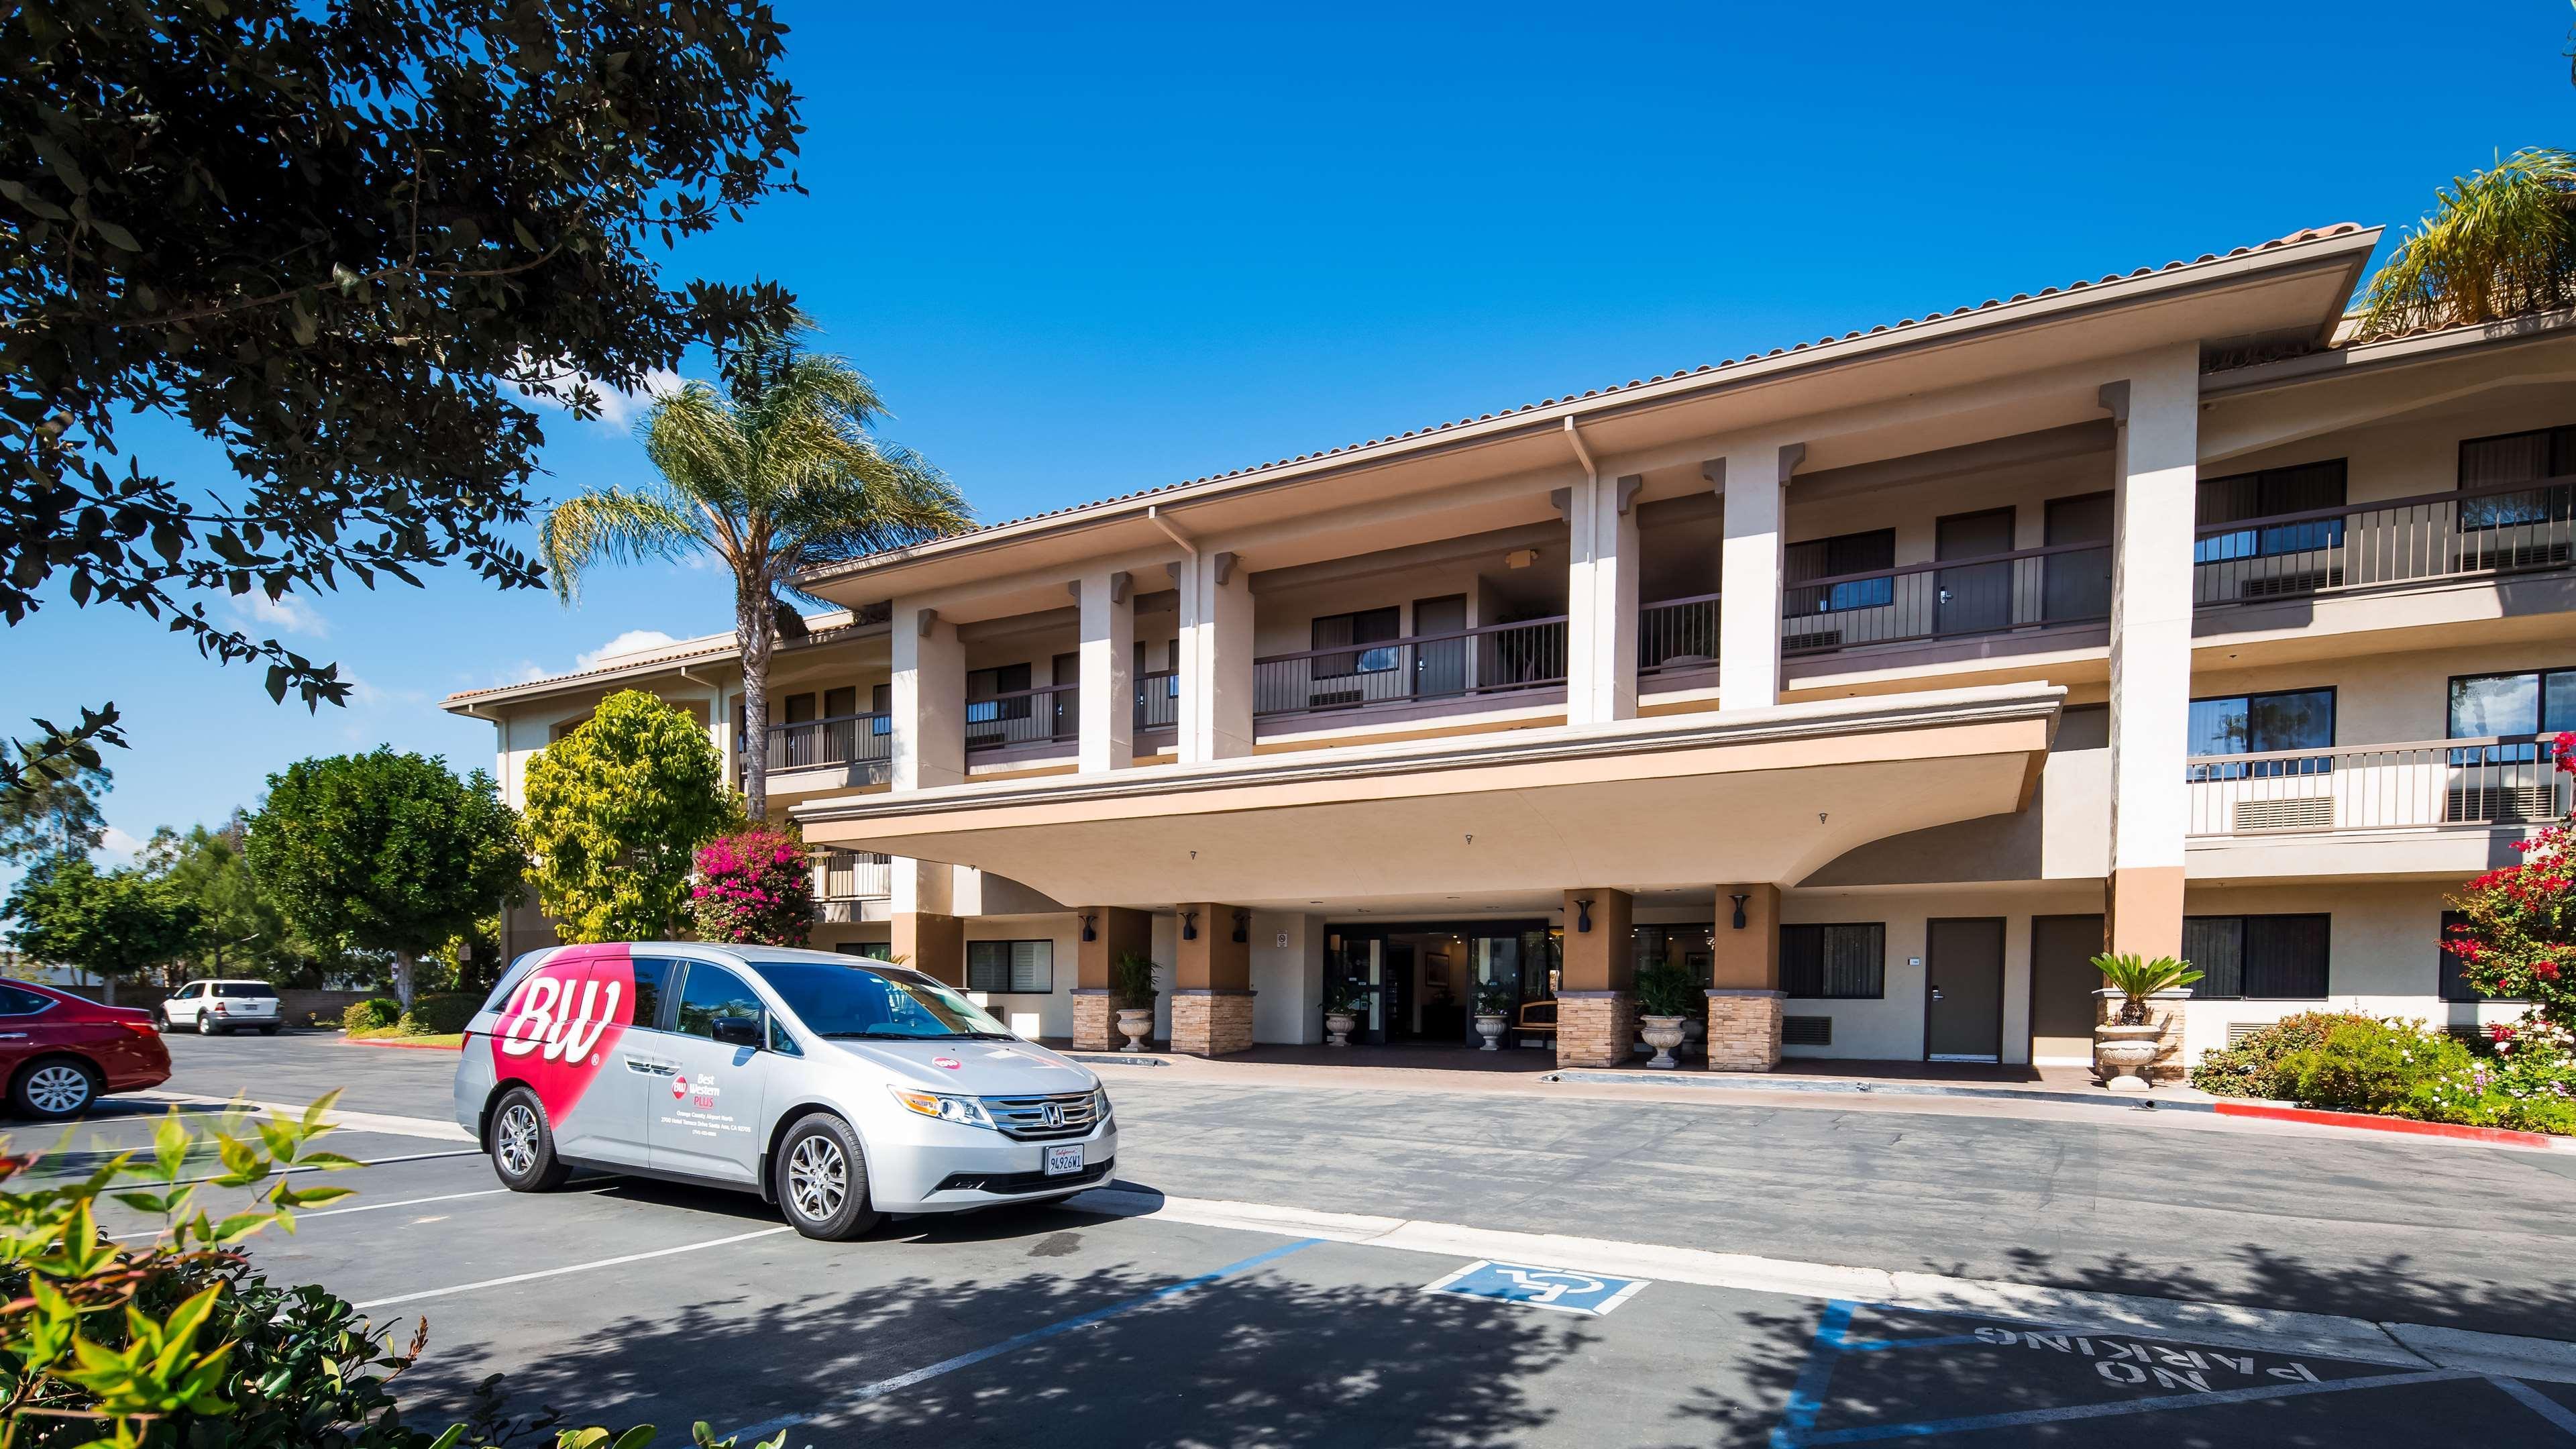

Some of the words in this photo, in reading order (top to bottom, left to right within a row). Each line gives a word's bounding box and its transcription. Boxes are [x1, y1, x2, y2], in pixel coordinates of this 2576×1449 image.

[502, 977, 621, 1063] BW
[697, 1073, 715, 1085] Best
[673, 1083, 686, 1093] BW
[689, 1083, 720, 1096] Western
[694, 1095, 714, 1107] PLUS
[692, 1112, 706, 1120] County
[706, 1113, 720, 1121] Airport
[1050, 1155, 1081, 1171] 94926W1
[1974, 1327, 2322, 1383] PARKING
[2094, 1360, 2212, 1393] NO
